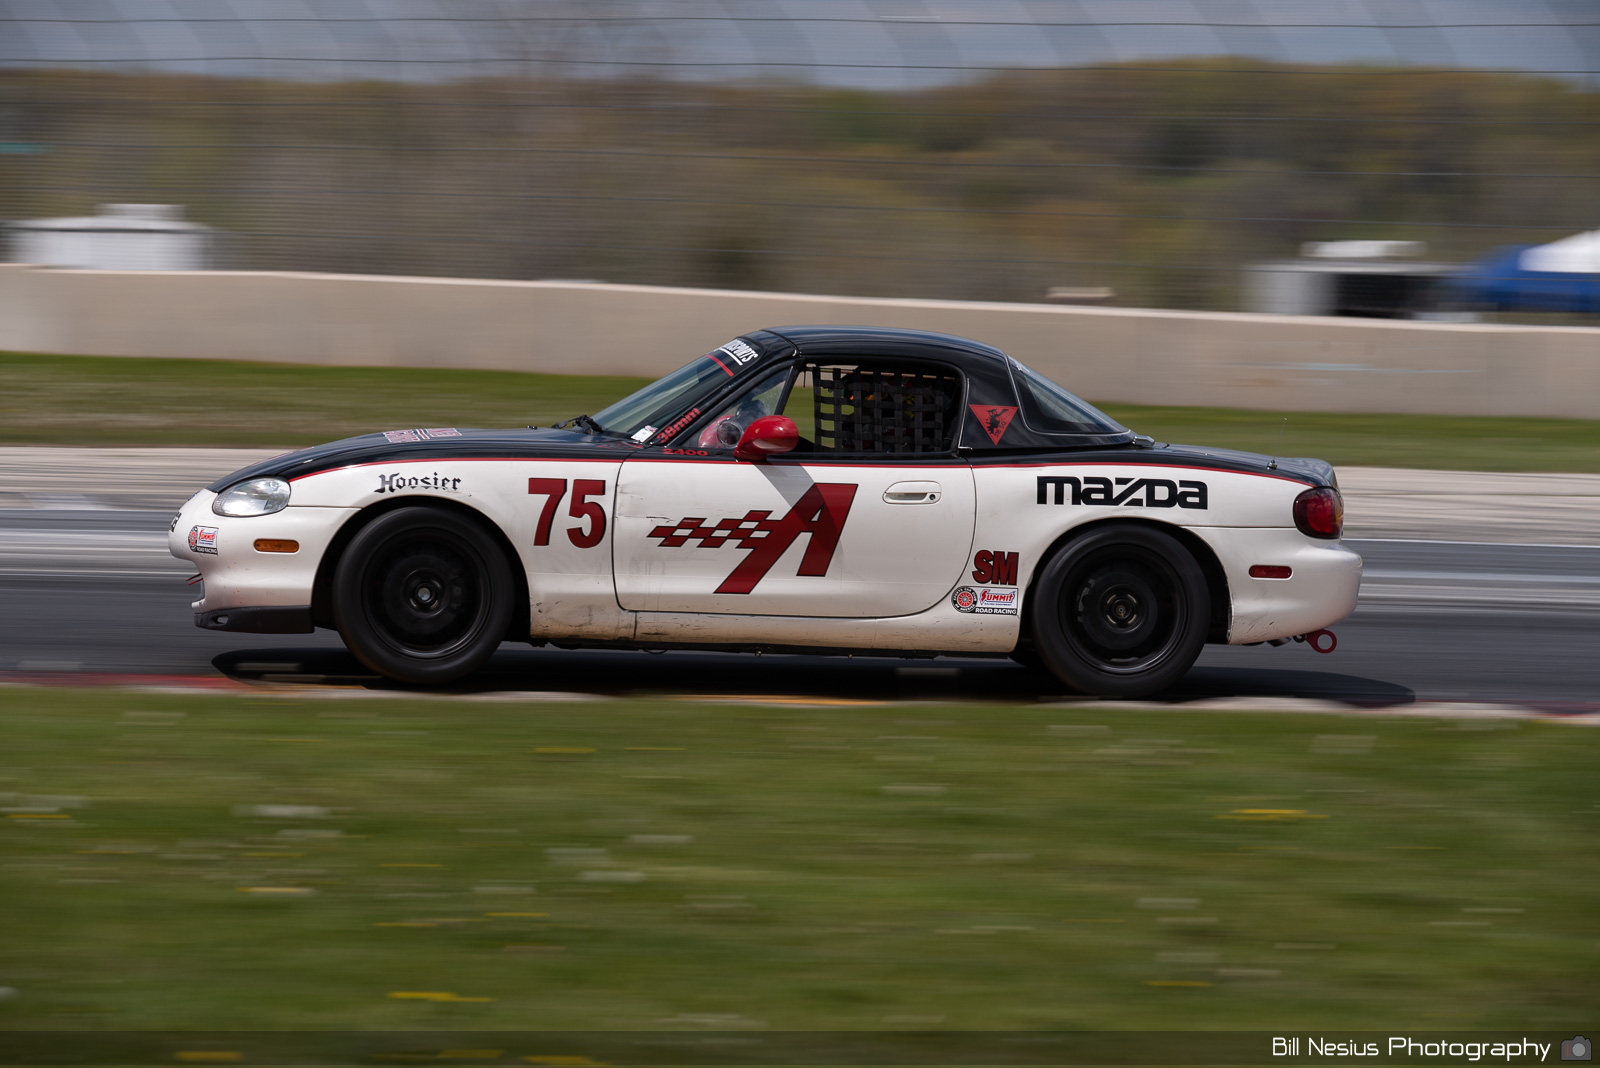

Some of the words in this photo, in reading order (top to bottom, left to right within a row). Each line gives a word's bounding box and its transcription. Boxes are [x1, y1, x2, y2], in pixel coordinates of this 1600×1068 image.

[656, 407, 701, 444] 38mm
[662, 448, 708, 457] 2400
[373, 471, 462, 494] Hoosier
[528, 477, 607, 549] 75
[972, 549, 1019, 586] SM
